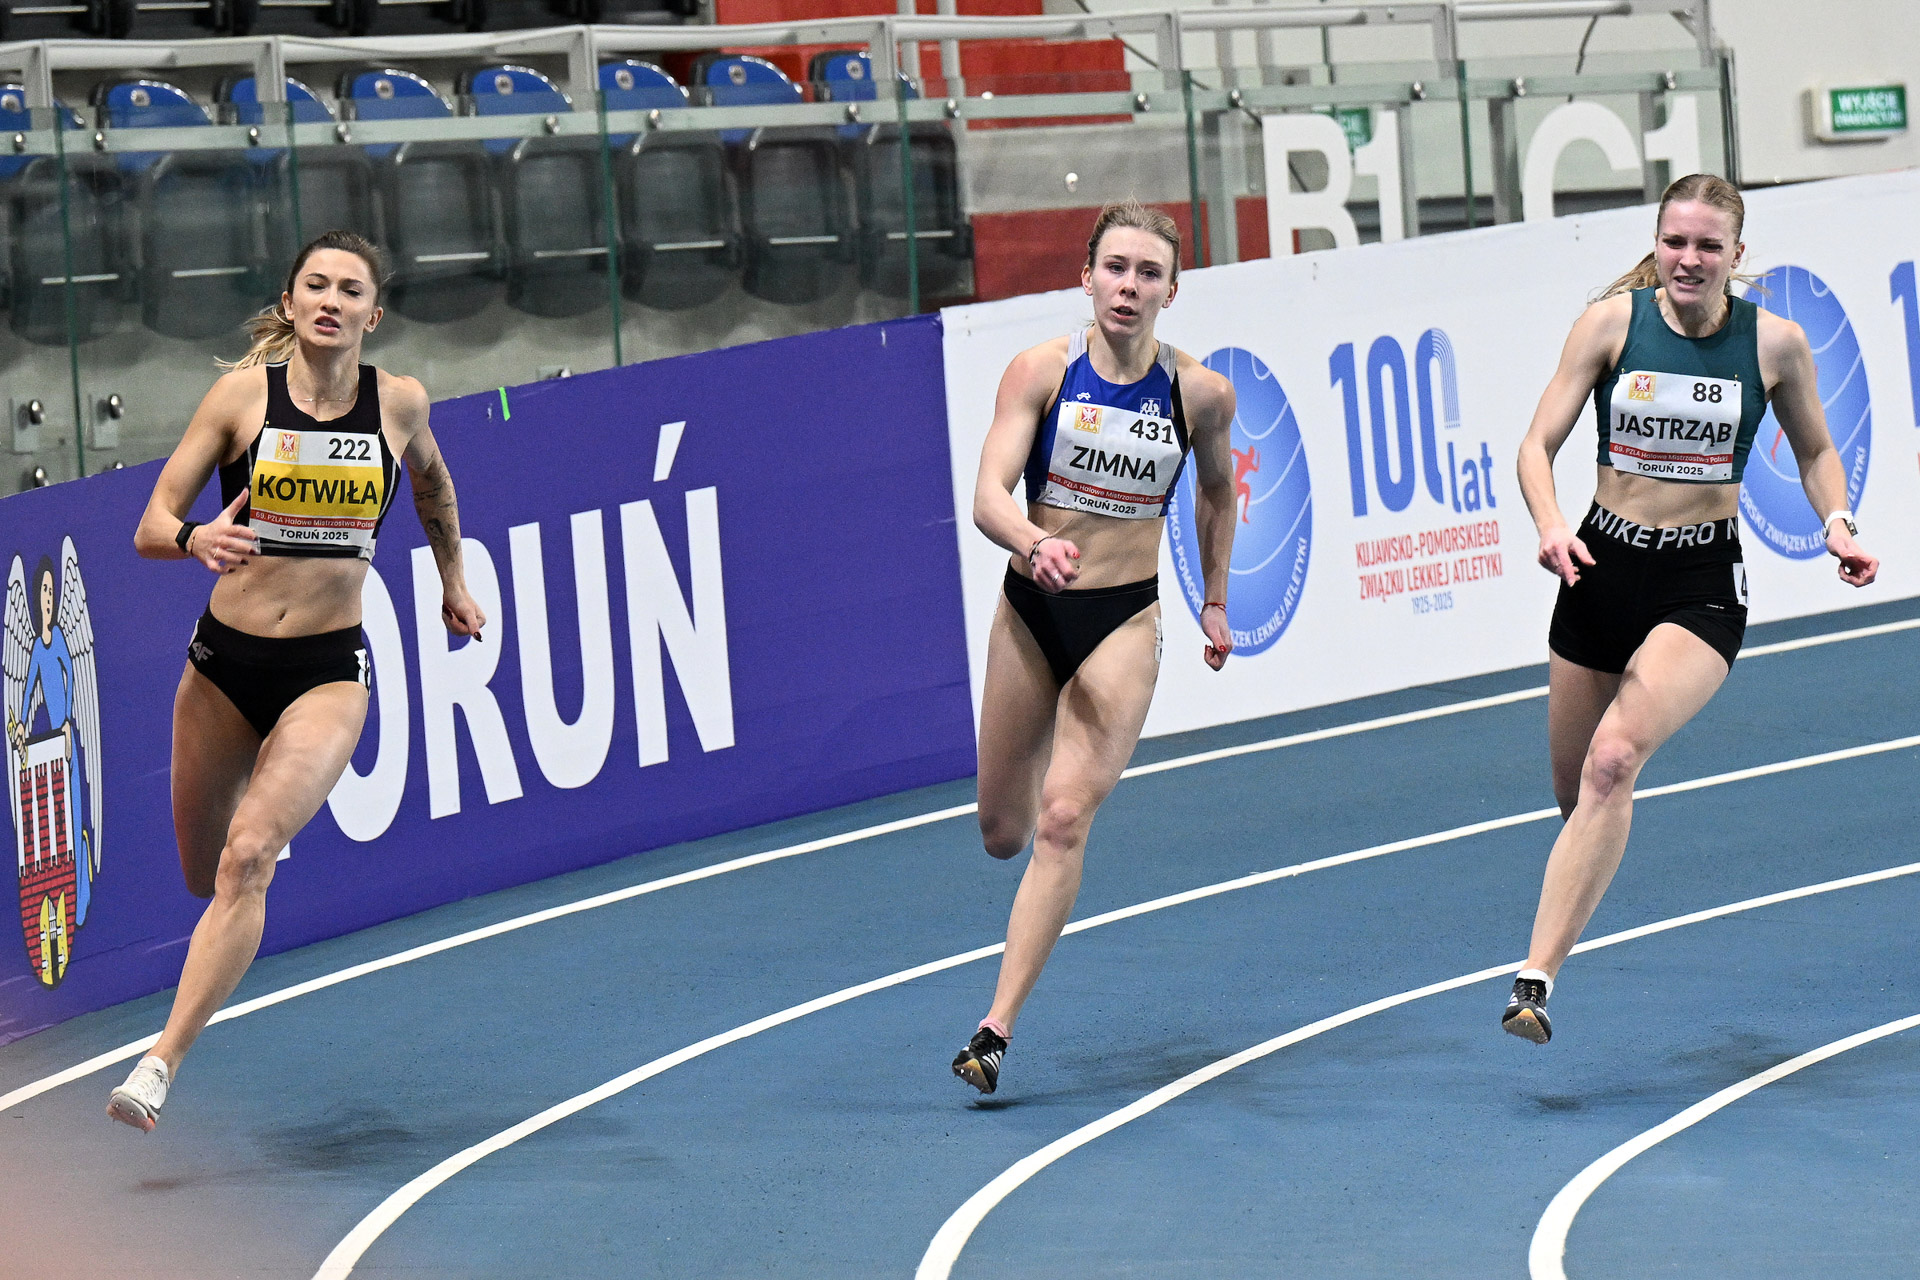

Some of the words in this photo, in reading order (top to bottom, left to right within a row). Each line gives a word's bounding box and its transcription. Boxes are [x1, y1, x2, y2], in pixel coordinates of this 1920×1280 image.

[1262, 110, 1404, 258] B1
[1692, 382, 1722, 403] 88
[1129, 418, 1173, 445] 431
[1328, 327, 1460, 517] 100
[1616, 413, 1732, 447] JASTRZĄB
[328, 438, 371, 460] 222
[1069, 445, 1156, 483] ZIMNA
[1710, 455, 1728, 463] Polski
[1447, 441, 1496, 514] lat
[1637, 462, 1674, 473] TORUŃ
[1676, 465, 1704, 475] 2025
[258, 474, 378, 504] KOTWIŁA
[1073, 494, 1110, 511] TORUŃ
[1111, 503, 1137, 514] 2025
[280, 528, 319, 540] TORUŃ
[322, 531, 349, 540] 2025
[285, 517, 312, 525] Halowe
[313, 519, 355, 528] Mistrzostwa
[356, 521, 375, 529] Polski
[1590, 506, 1655, 549] NIKE
[1656, 522, 1715, 550] PRO
[1761, 522, 1807, 554] ZWIĄZEK
[1355, 520, 1500, 568] KUJAWSKO-POMORSKIEGO
[1251, 609, 1288, 646] LEKKIEJ
[1284, 537, 1308, 613] ATLETYKI
[1359, 569, 1404, 603] ZWIĄZKU
[1407, 560, 1450, 592] LEKKIEJ
[1453, 553, 1503, 584] ATLETYKI
[1411, 591, 1454, 615] 1925-2025
[277, 421, 735, 861] ORUŃ
